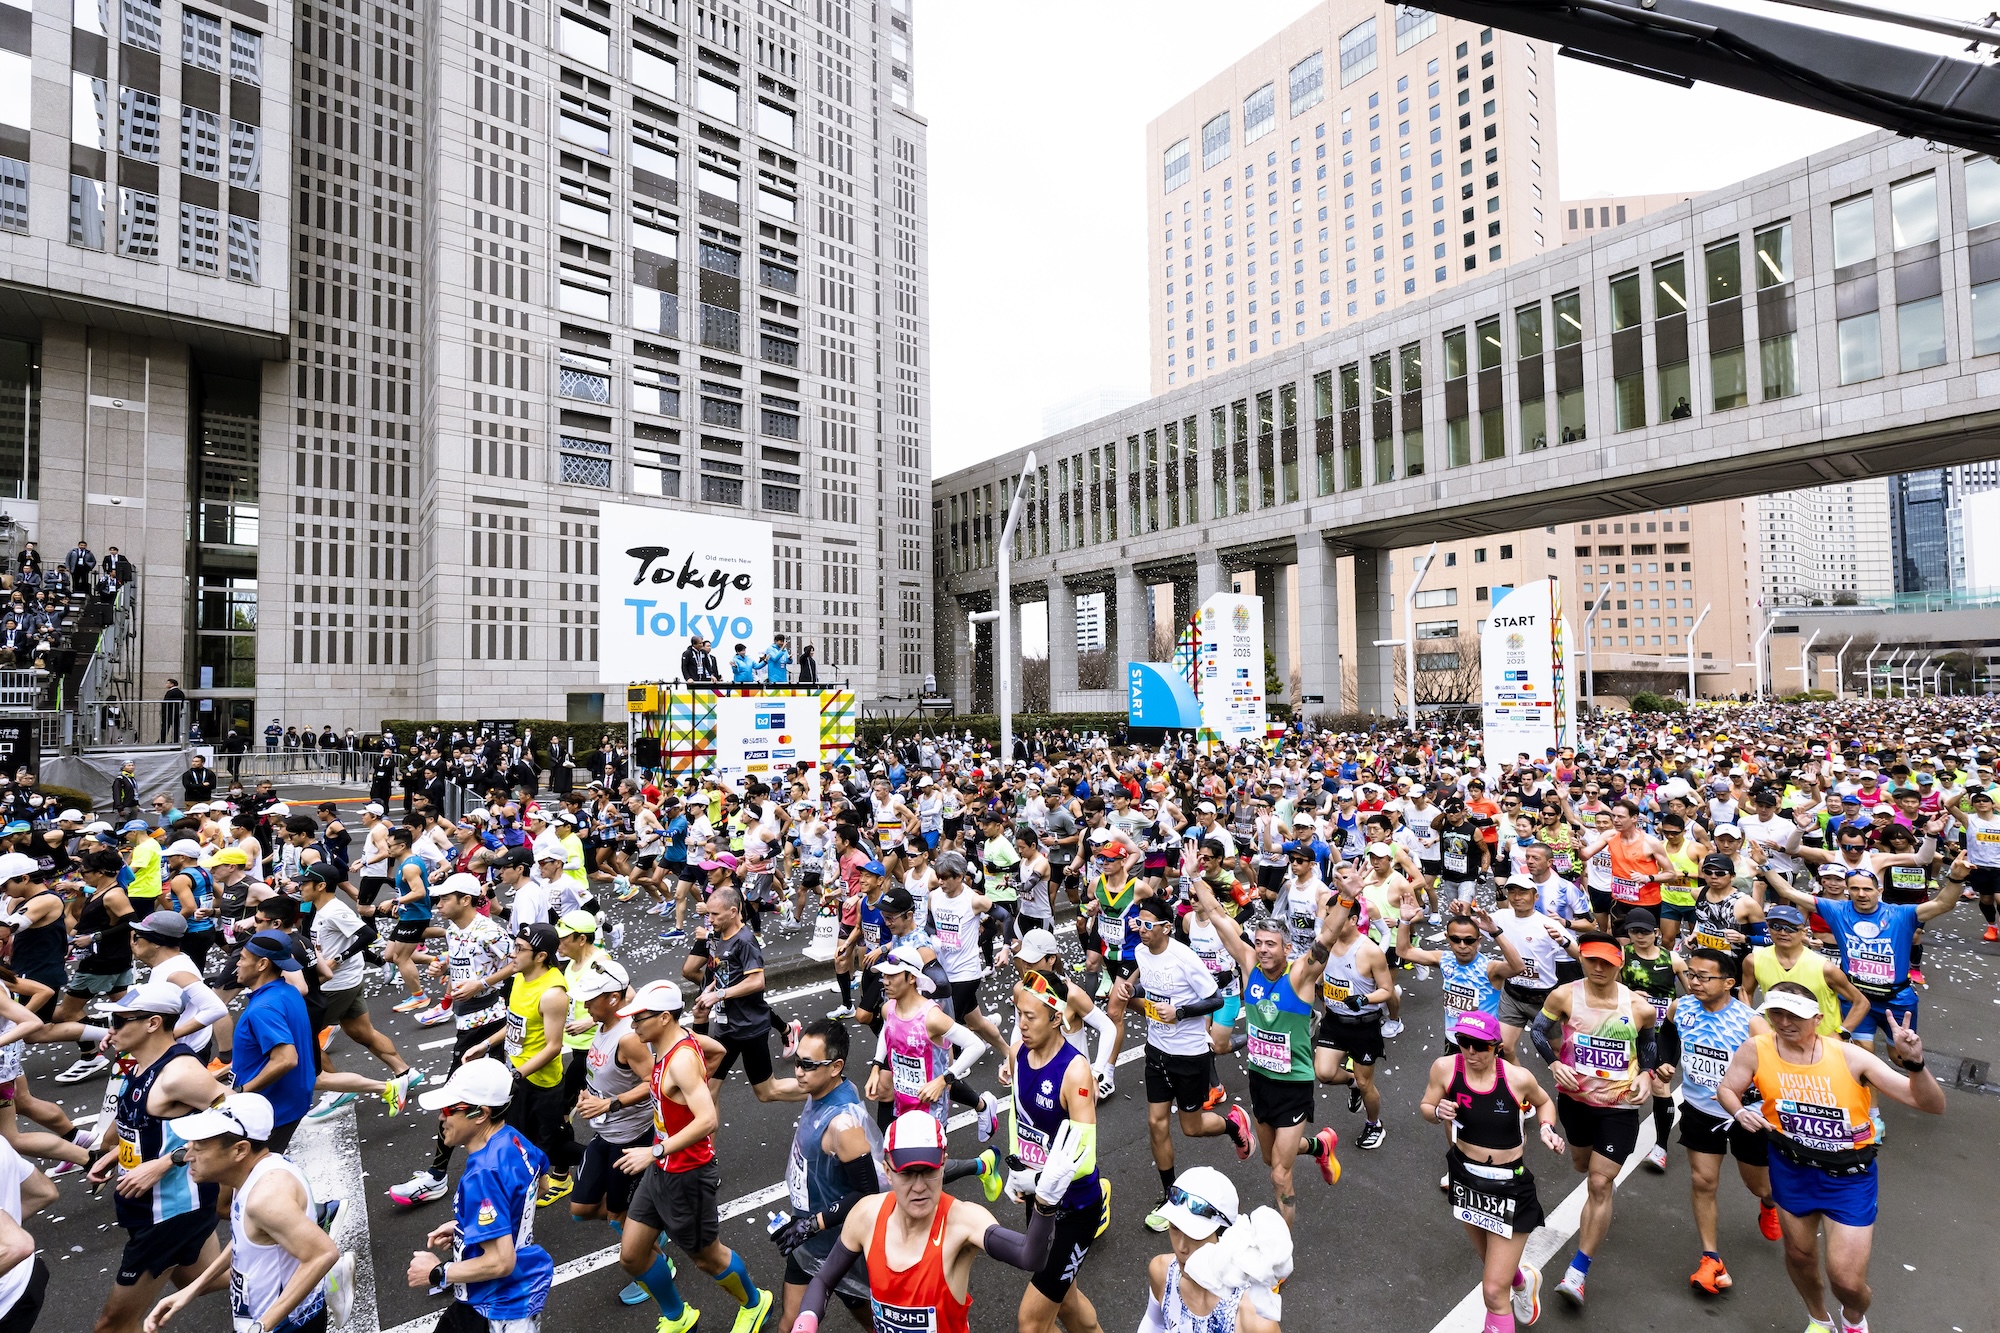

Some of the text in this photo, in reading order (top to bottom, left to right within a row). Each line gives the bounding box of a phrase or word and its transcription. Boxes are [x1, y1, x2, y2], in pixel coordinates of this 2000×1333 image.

[625, 546, 753, 610] Tokyo
[624, 598, 753, 649] Tokyo
[1493, 615, 1535, 628] START
[1233, 635, 1251, 643] TOKYO
[1233, 648, 1251, 658] 2025
[1131, 669, 1143, 718] START
[1861, 953, 1890, 962] 東京メトロ
[1857, 961, 1888, 976] 25701
[1446, 992, 1472, 1011] 23876
[1460, 1016, 1486, 1030] HOKA
[1258, 1031, 1284, 1042] 東京メトロ
[1592, 1039, 1624, 1049] 東京メトロ
[1254, 1041, 1284, 1059] 21923
[1575, 1047, 1623, 1068] C 21506
[1696, 1047, 1727, 1059] 東京メトロ
[1691, 1056, 1726, 1077] 22018
[1776, 1071, 1832, 1092] VISUALLY
[1035, 1092, 1054, 1110] TOKYO
[1779, 1087, 1837, 1108] IMPAIRED
[1799, 1105, 1841, 1118] 東京メトロ
[1018, 1125, 1042, 1144] 東京メトロ
[1779, 1114, 1844, 1138] C 24656
[1803, 1138, 1846, 1153] STARTS
[1455, 1185, 1507, 1217] C 11354
[523, 1207, 531, 1220] C
[1472, 1212, 1504, 1234] STARTS
[884, 1308, 926, 1323] 東京メトロ
